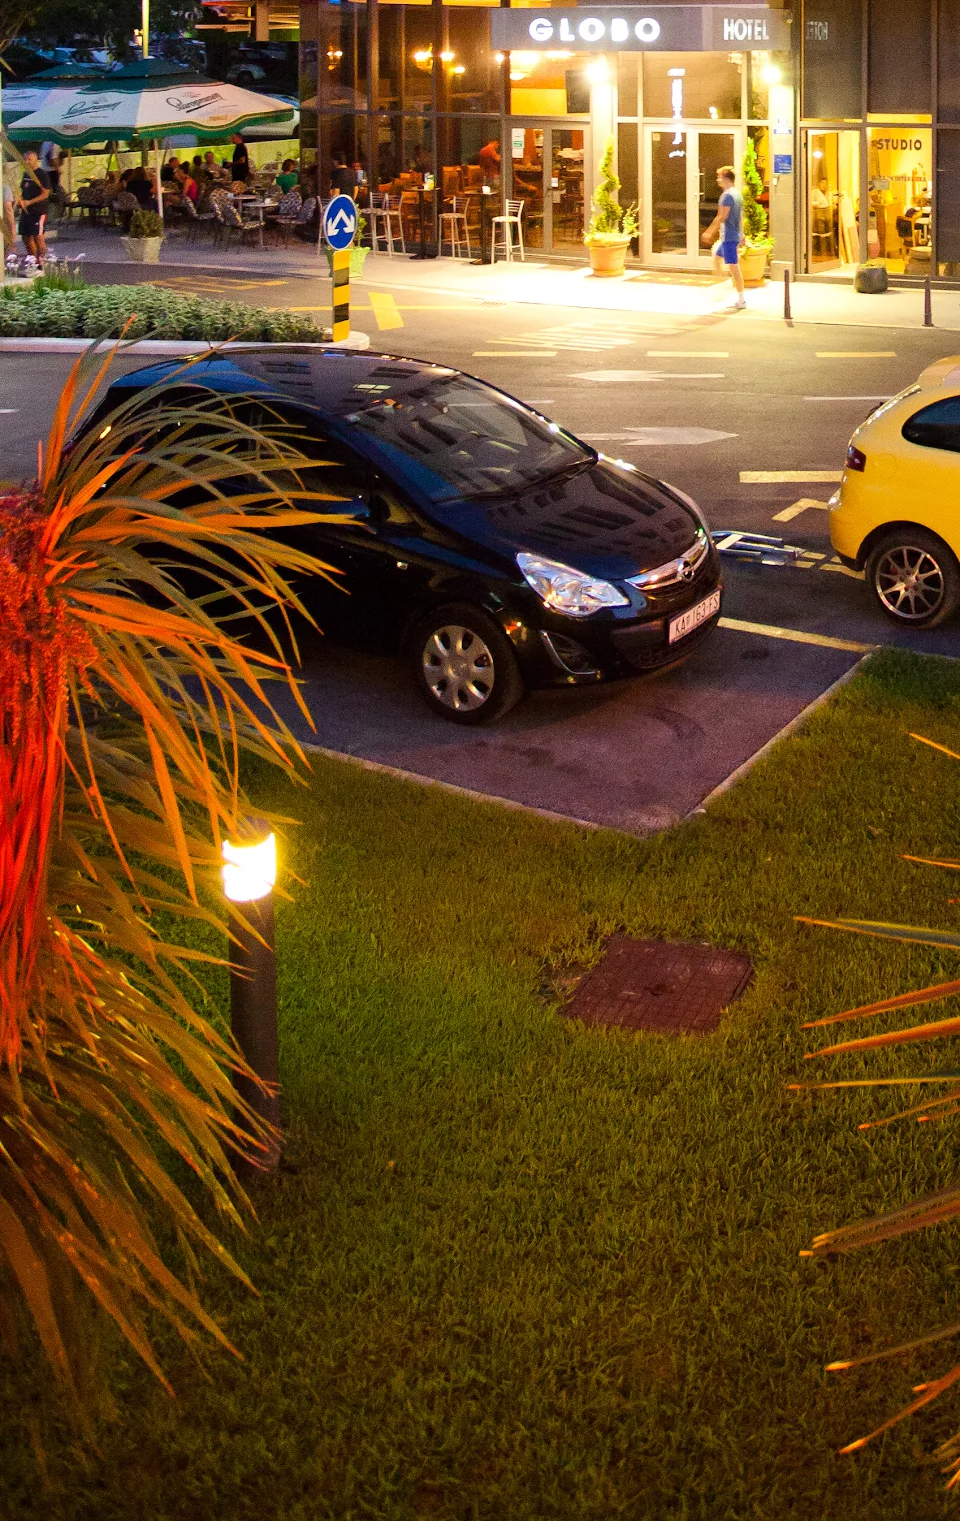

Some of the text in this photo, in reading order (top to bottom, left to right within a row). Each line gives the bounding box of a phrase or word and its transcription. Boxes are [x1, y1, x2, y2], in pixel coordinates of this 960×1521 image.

[528, 17, 770, 42] GLOBO HOTEL
[877, 138, 922, 150] STUDIO
[675, 616, 686, 636] KA
